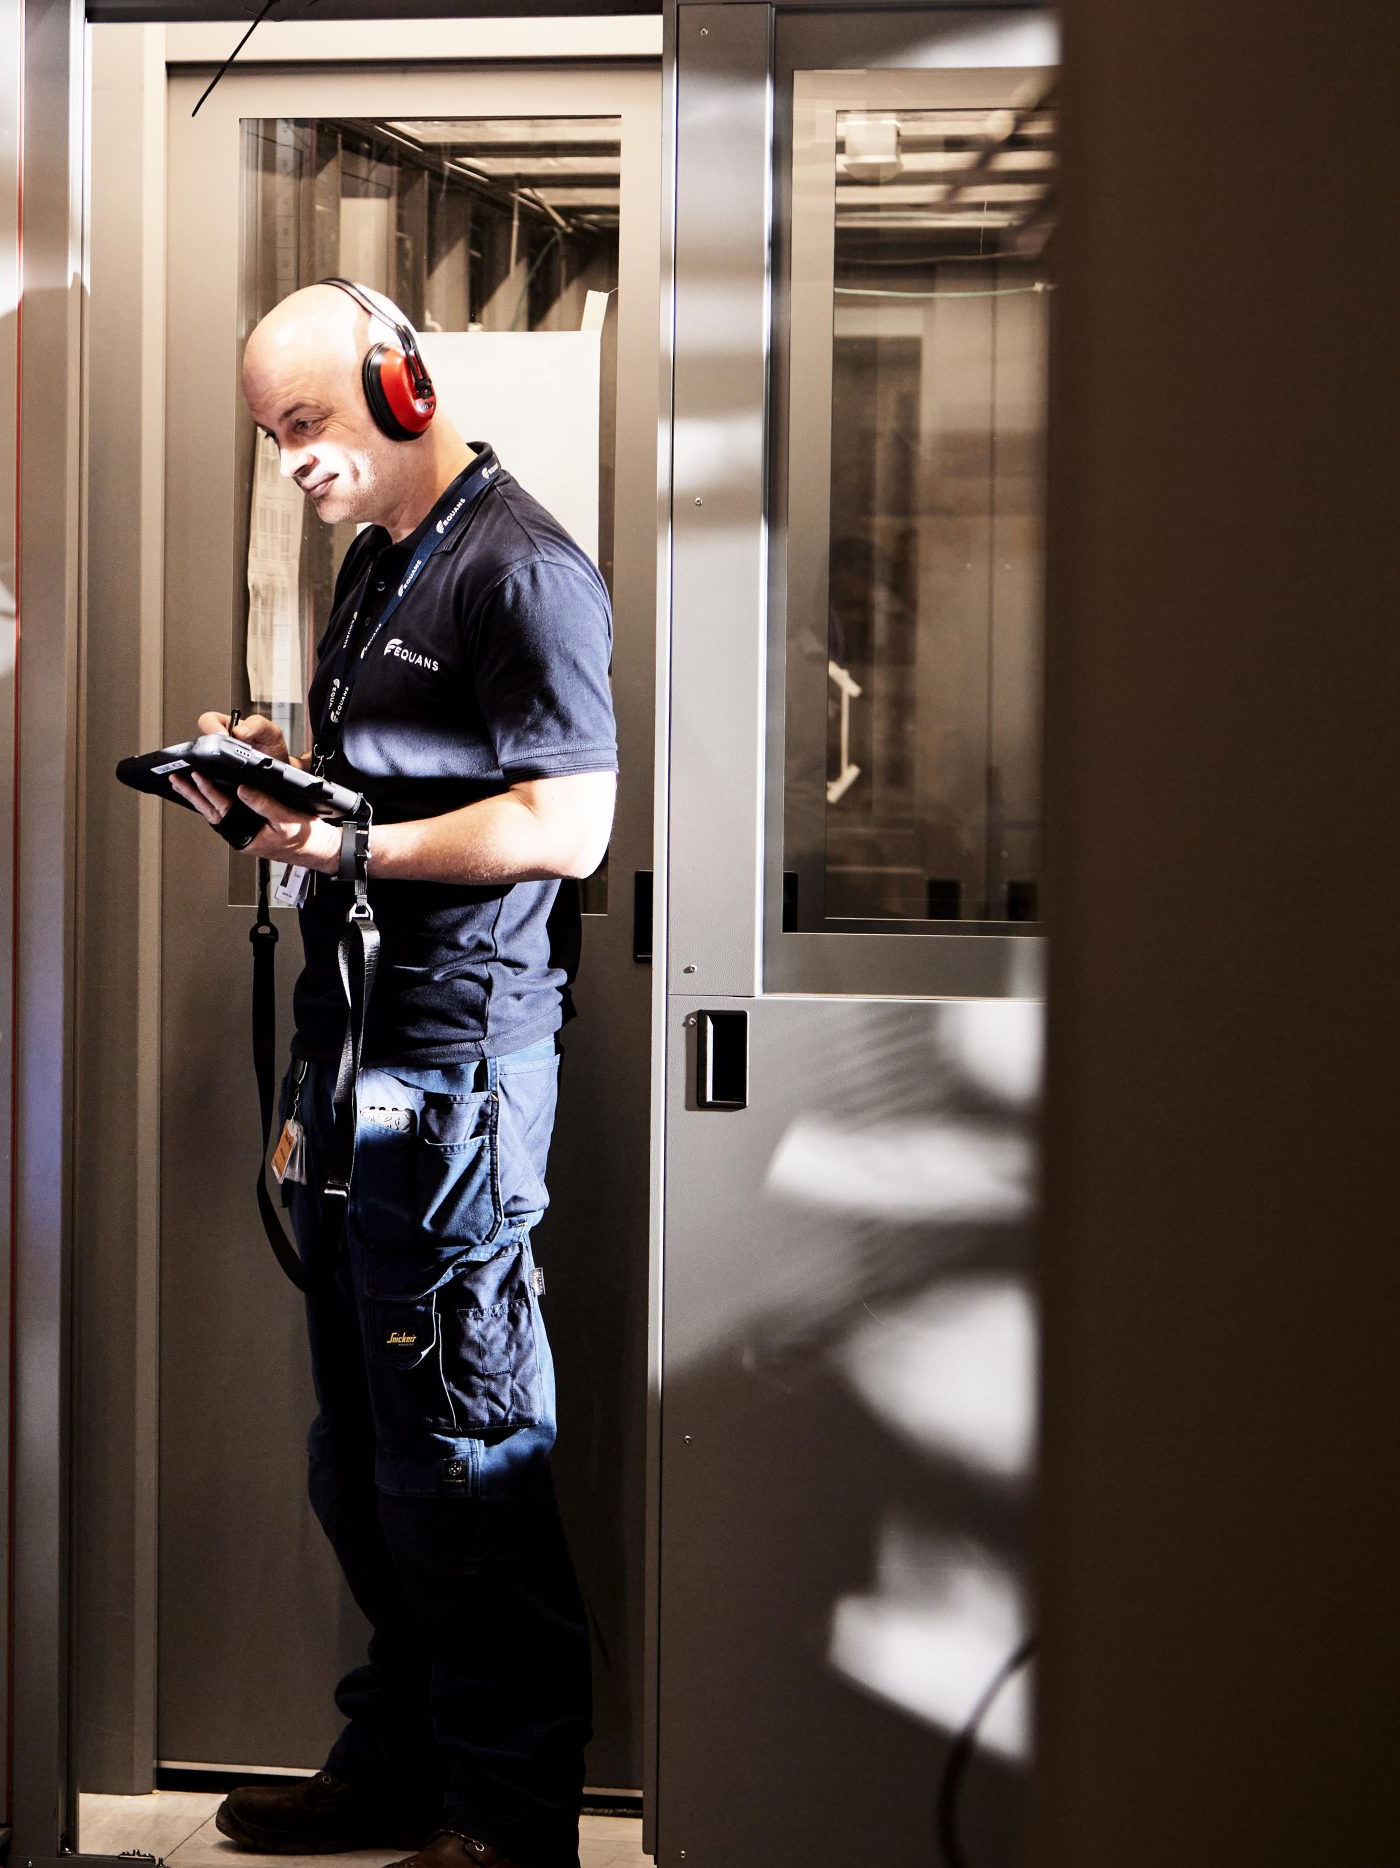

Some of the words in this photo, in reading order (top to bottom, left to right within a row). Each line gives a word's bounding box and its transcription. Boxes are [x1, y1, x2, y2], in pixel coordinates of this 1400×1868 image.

[443, 498, 466, 527] EQUANS
[403, 560, 422, 590] EQUANS
[393, 646, 439, 672] EQUANS
